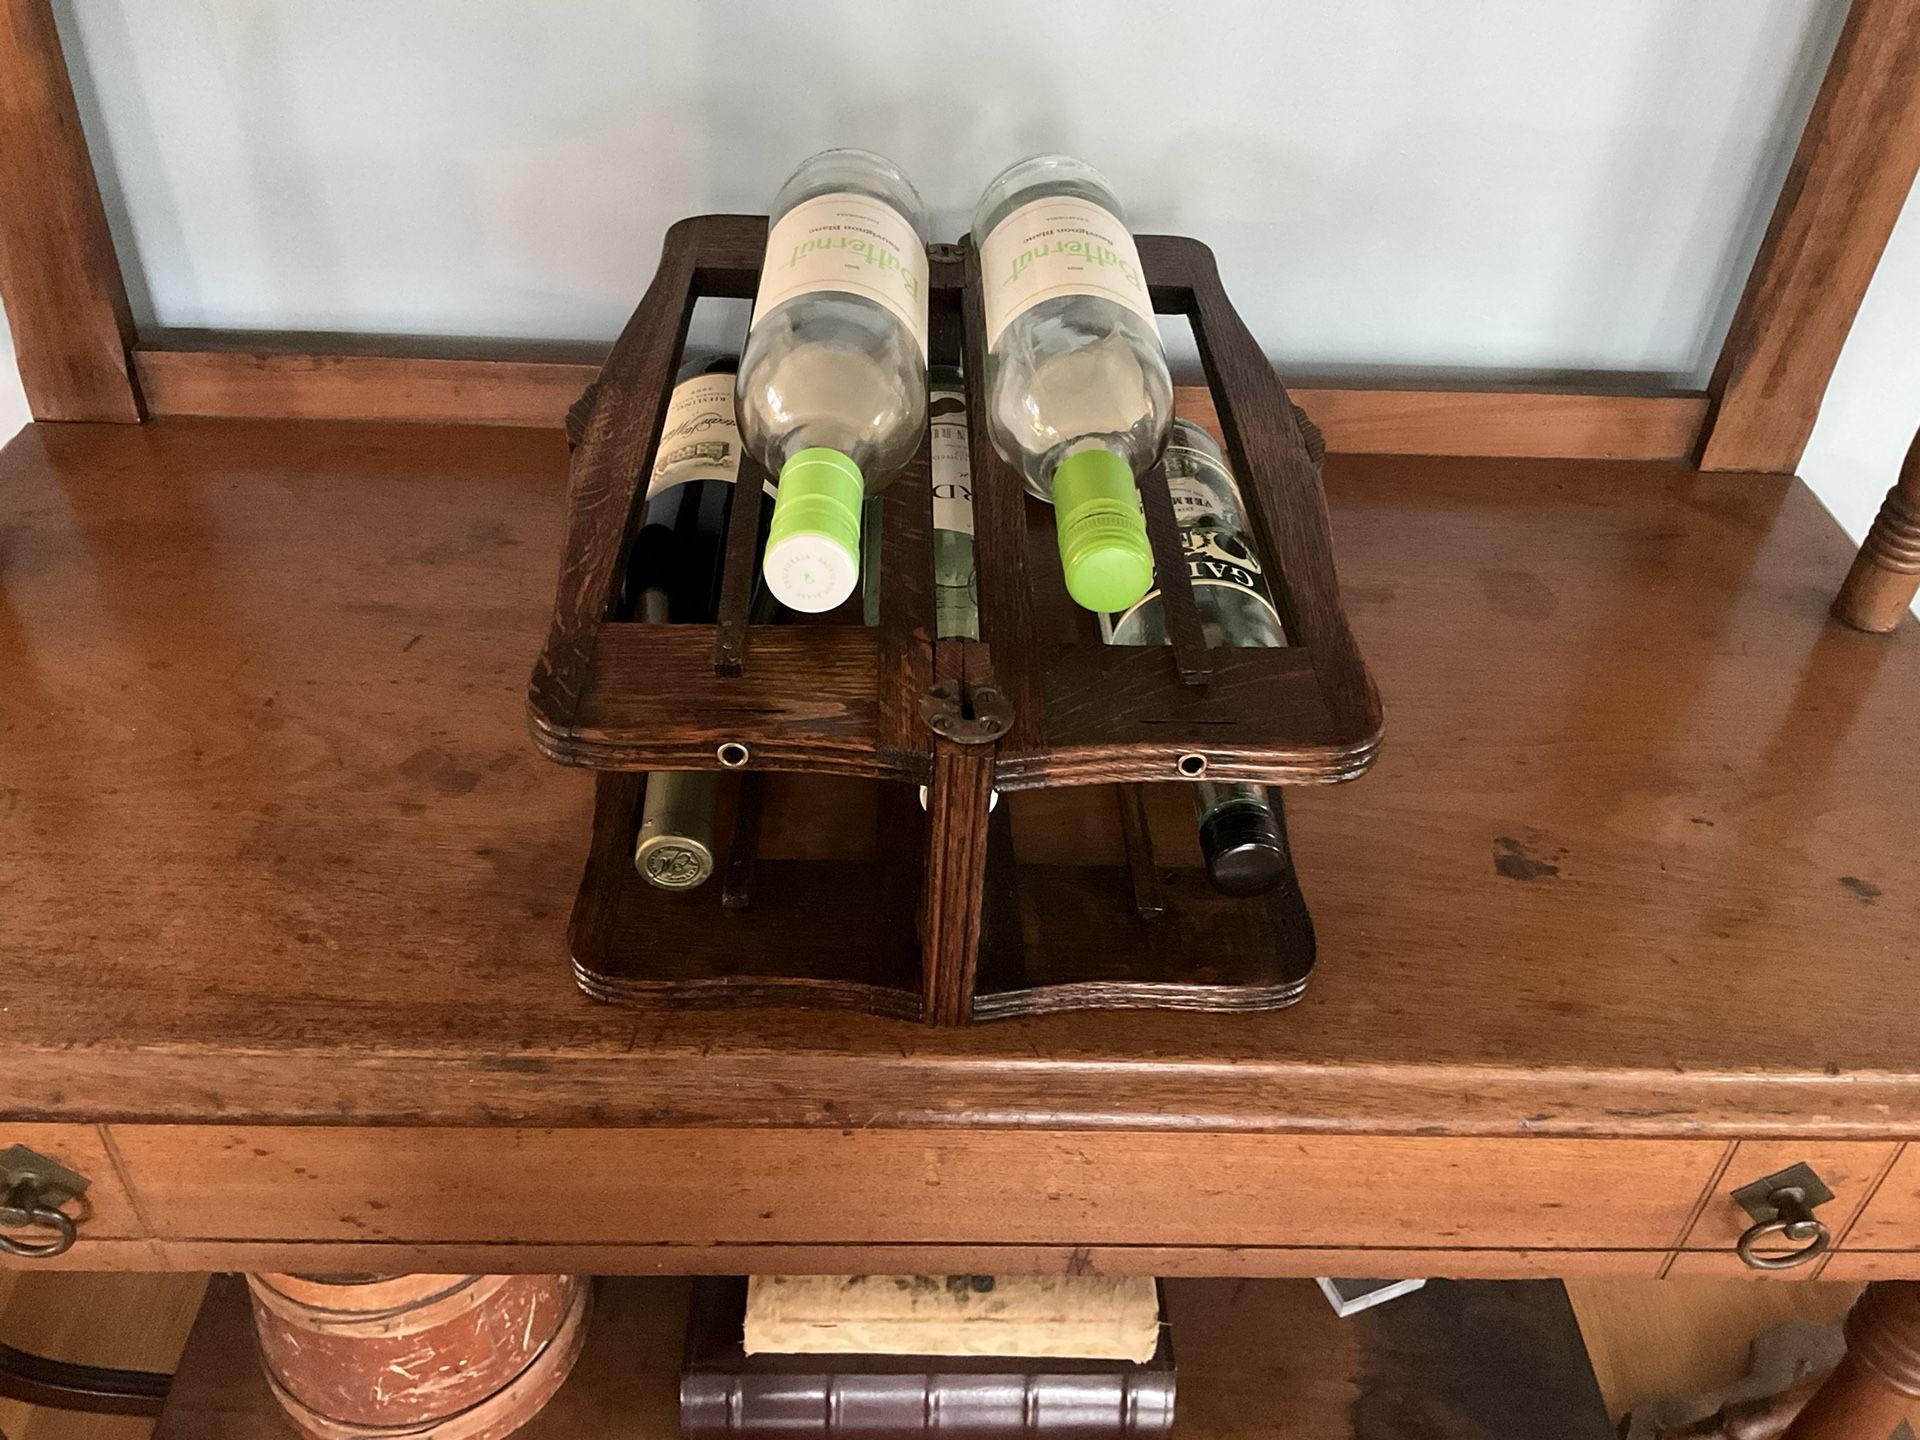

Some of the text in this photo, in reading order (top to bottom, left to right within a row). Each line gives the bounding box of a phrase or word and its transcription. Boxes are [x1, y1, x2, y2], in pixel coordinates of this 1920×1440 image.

[808, 225, 841, 235] Blanc
[1022, 229, 1054, 244] Blanc
[780, 237, 919, 304] Butternut
[1003, 240, 1142, 292] Butternut
